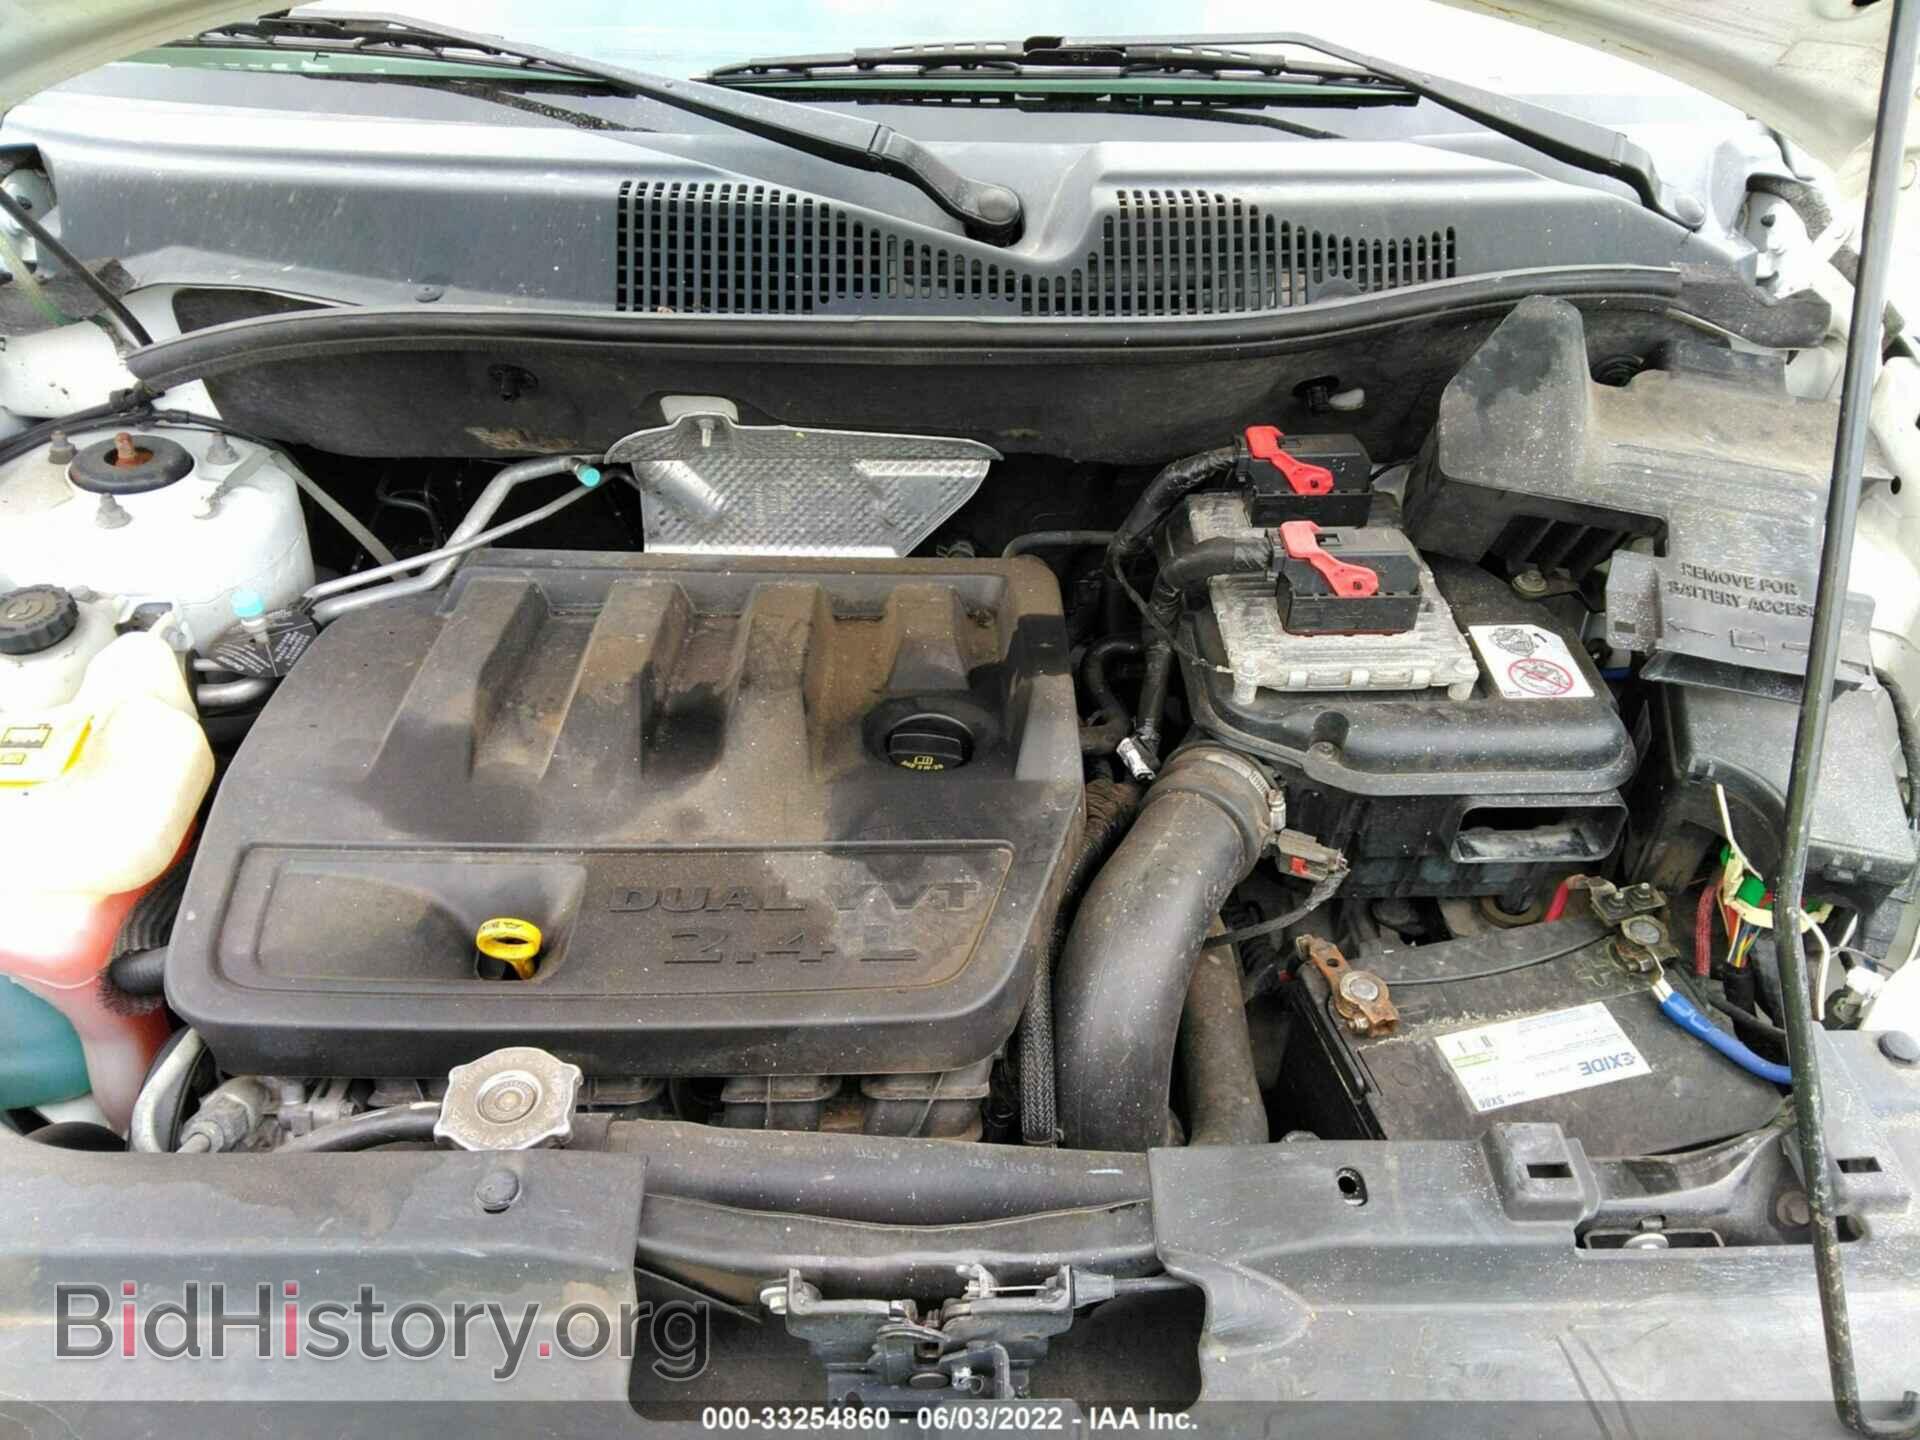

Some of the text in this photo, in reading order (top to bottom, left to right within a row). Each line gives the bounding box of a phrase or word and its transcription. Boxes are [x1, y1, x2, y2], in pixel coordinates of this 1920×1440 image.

[1680, 562, 1798, 596] REMOVE FOR
[1667, 580, 1742, 608] BATTERY
[607, 886, 807, 913] DUAL
[1578, 1052, 1636, 1076] EXIDE
